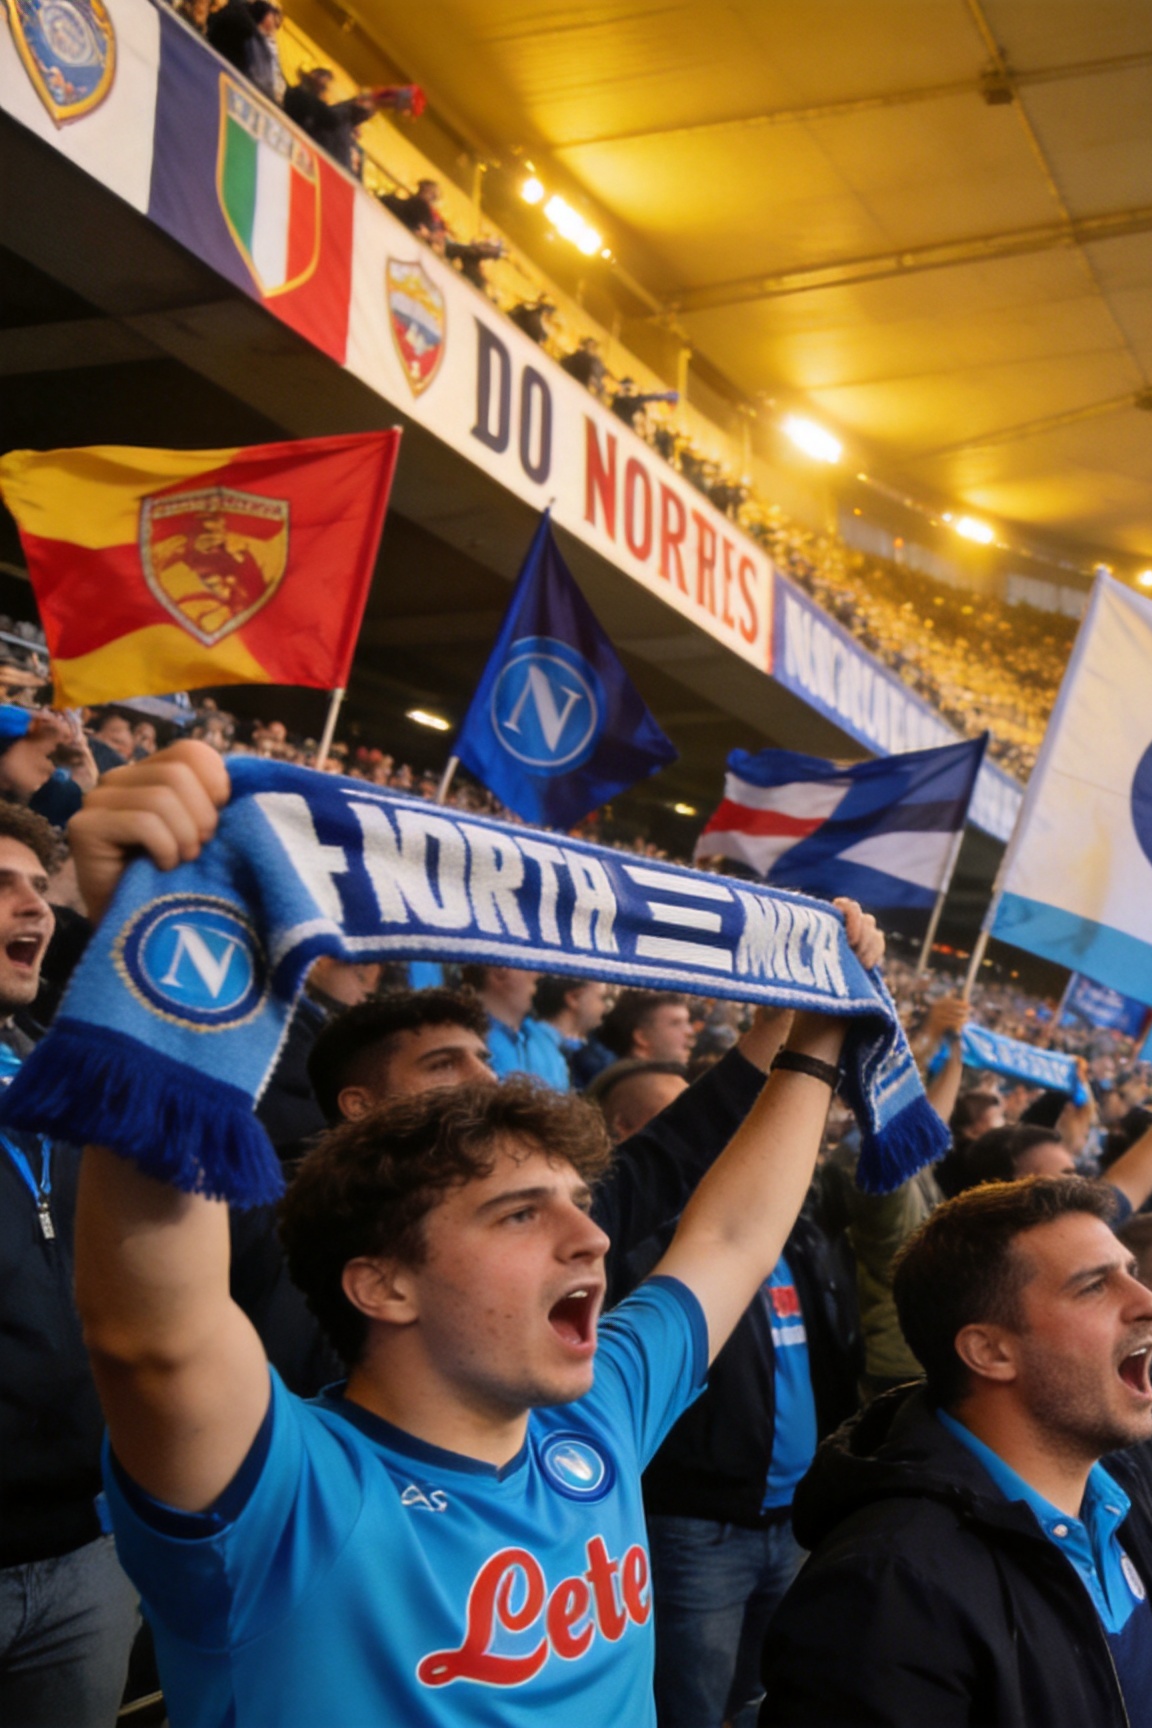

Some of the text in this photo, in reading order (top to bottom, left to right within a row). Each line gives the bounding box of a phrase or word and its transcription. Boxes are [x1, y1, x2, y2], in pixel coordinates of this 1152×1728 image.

[471, 314, 553, 486] DO
[502, 664, 583, 753] N
[159, 923, 240, 999] N
[415, 1533, 651, 1689] Lete
